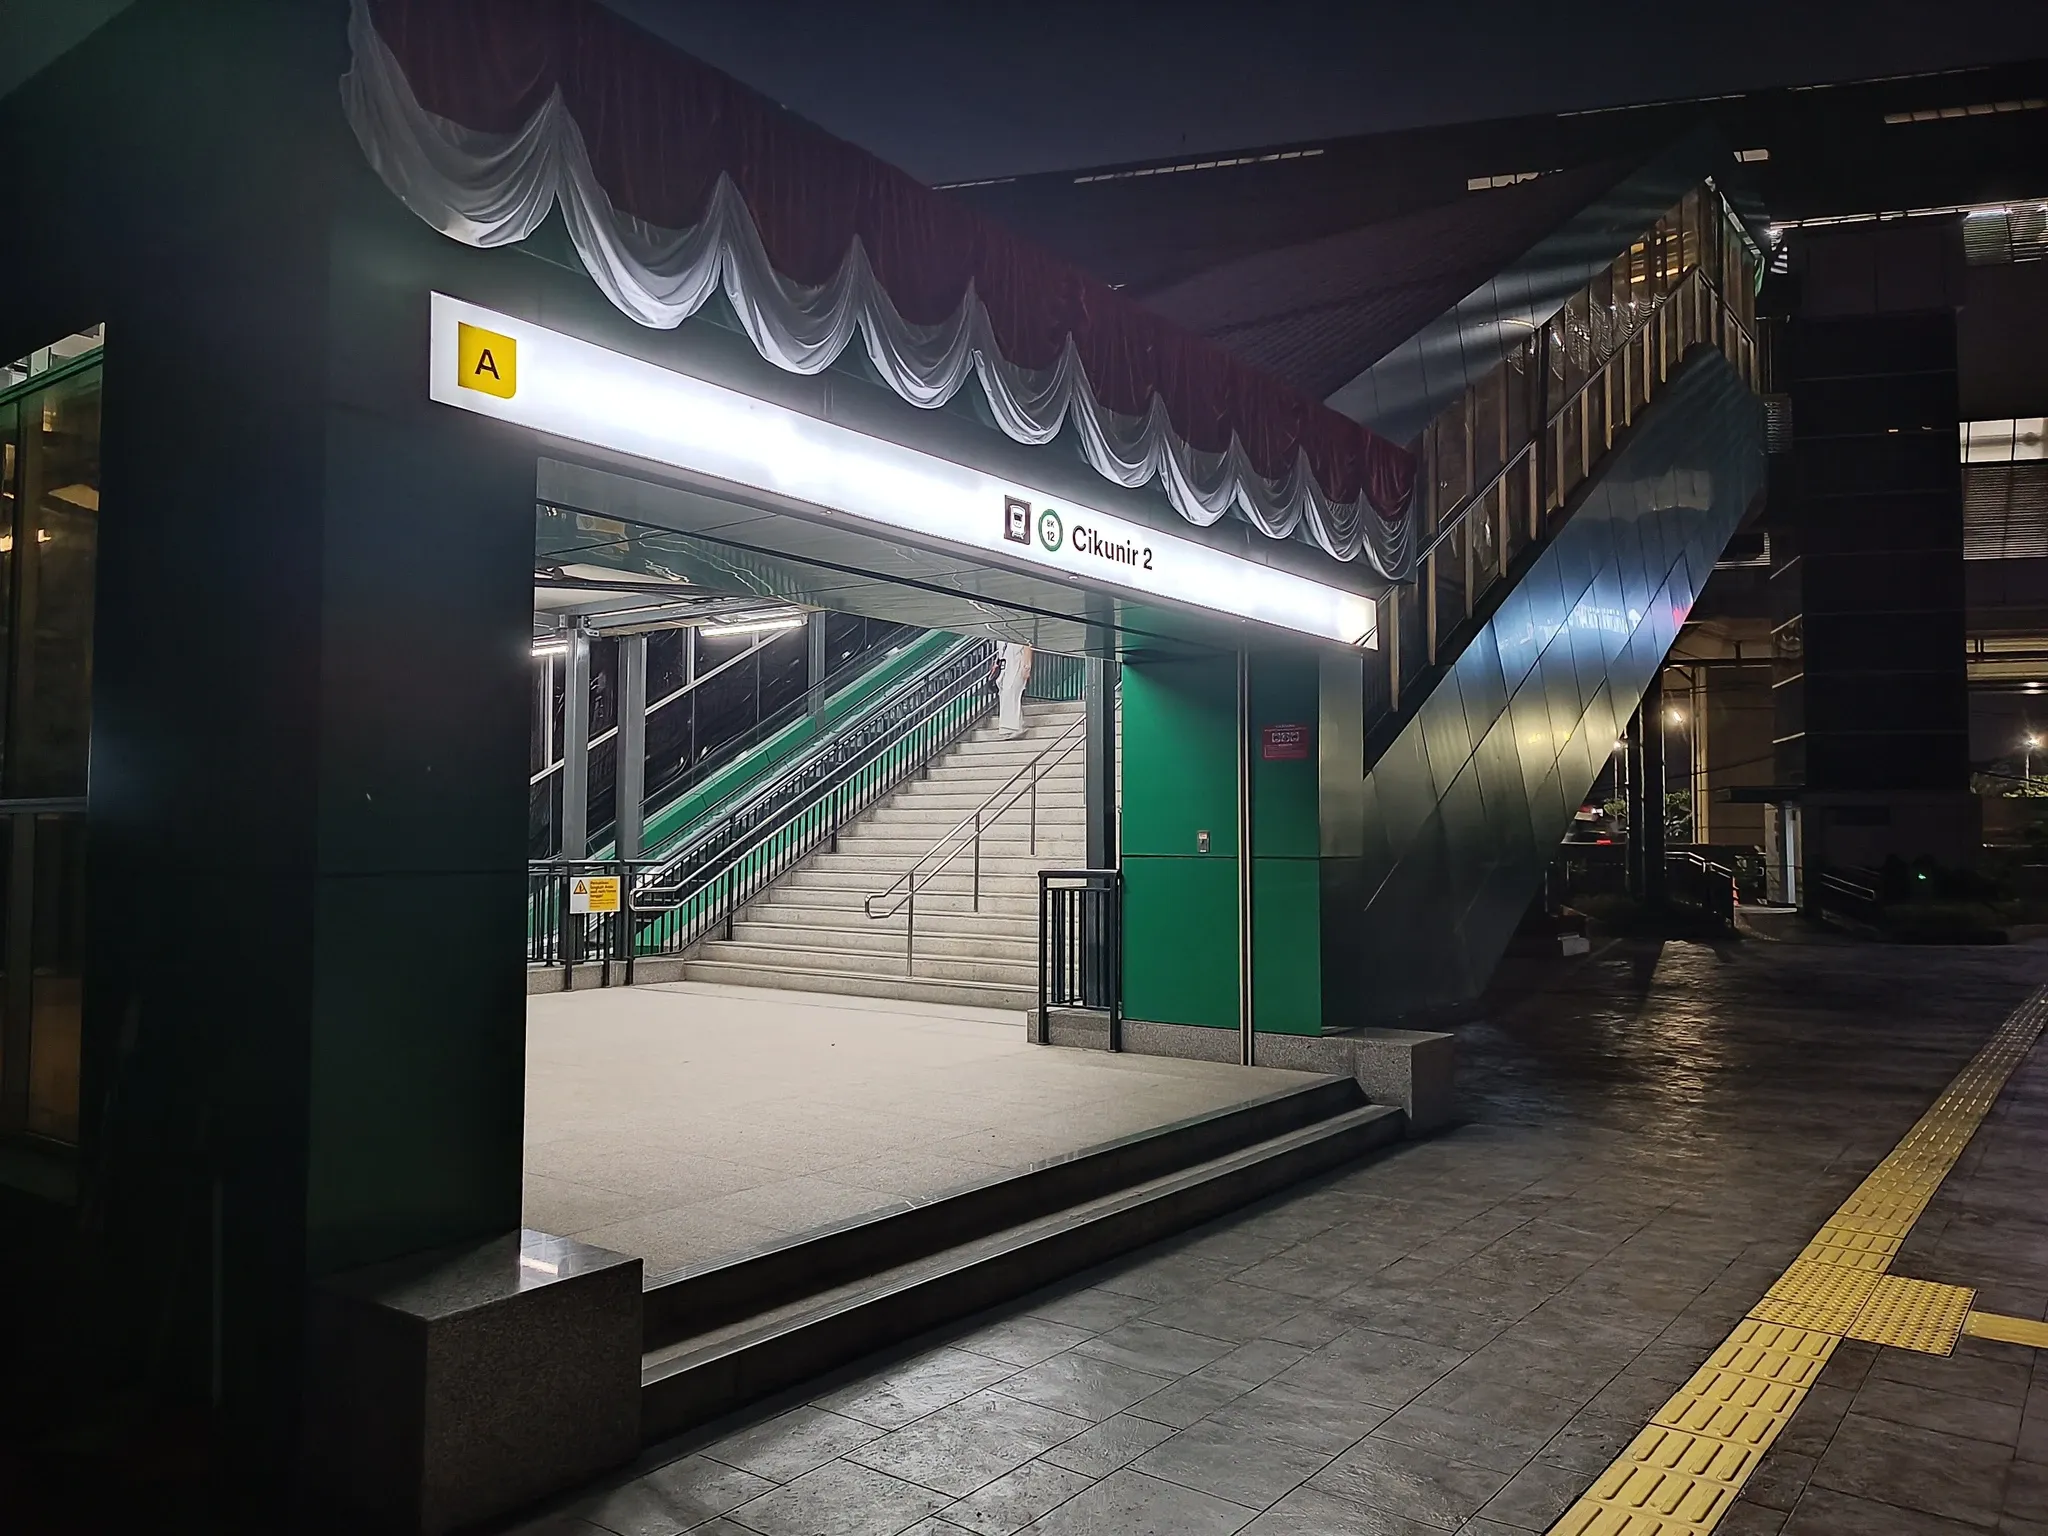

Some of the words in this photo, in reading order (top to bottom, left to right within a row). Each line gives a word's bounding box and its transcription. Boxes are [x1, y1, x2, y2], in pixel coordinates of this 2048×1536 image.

[474, 348, 500, 380] A
[1046, 530, 1055, 542] 12
[1072, 525, 1139, 566] Cikunir
[1143, 547, 1153, 570] 2
